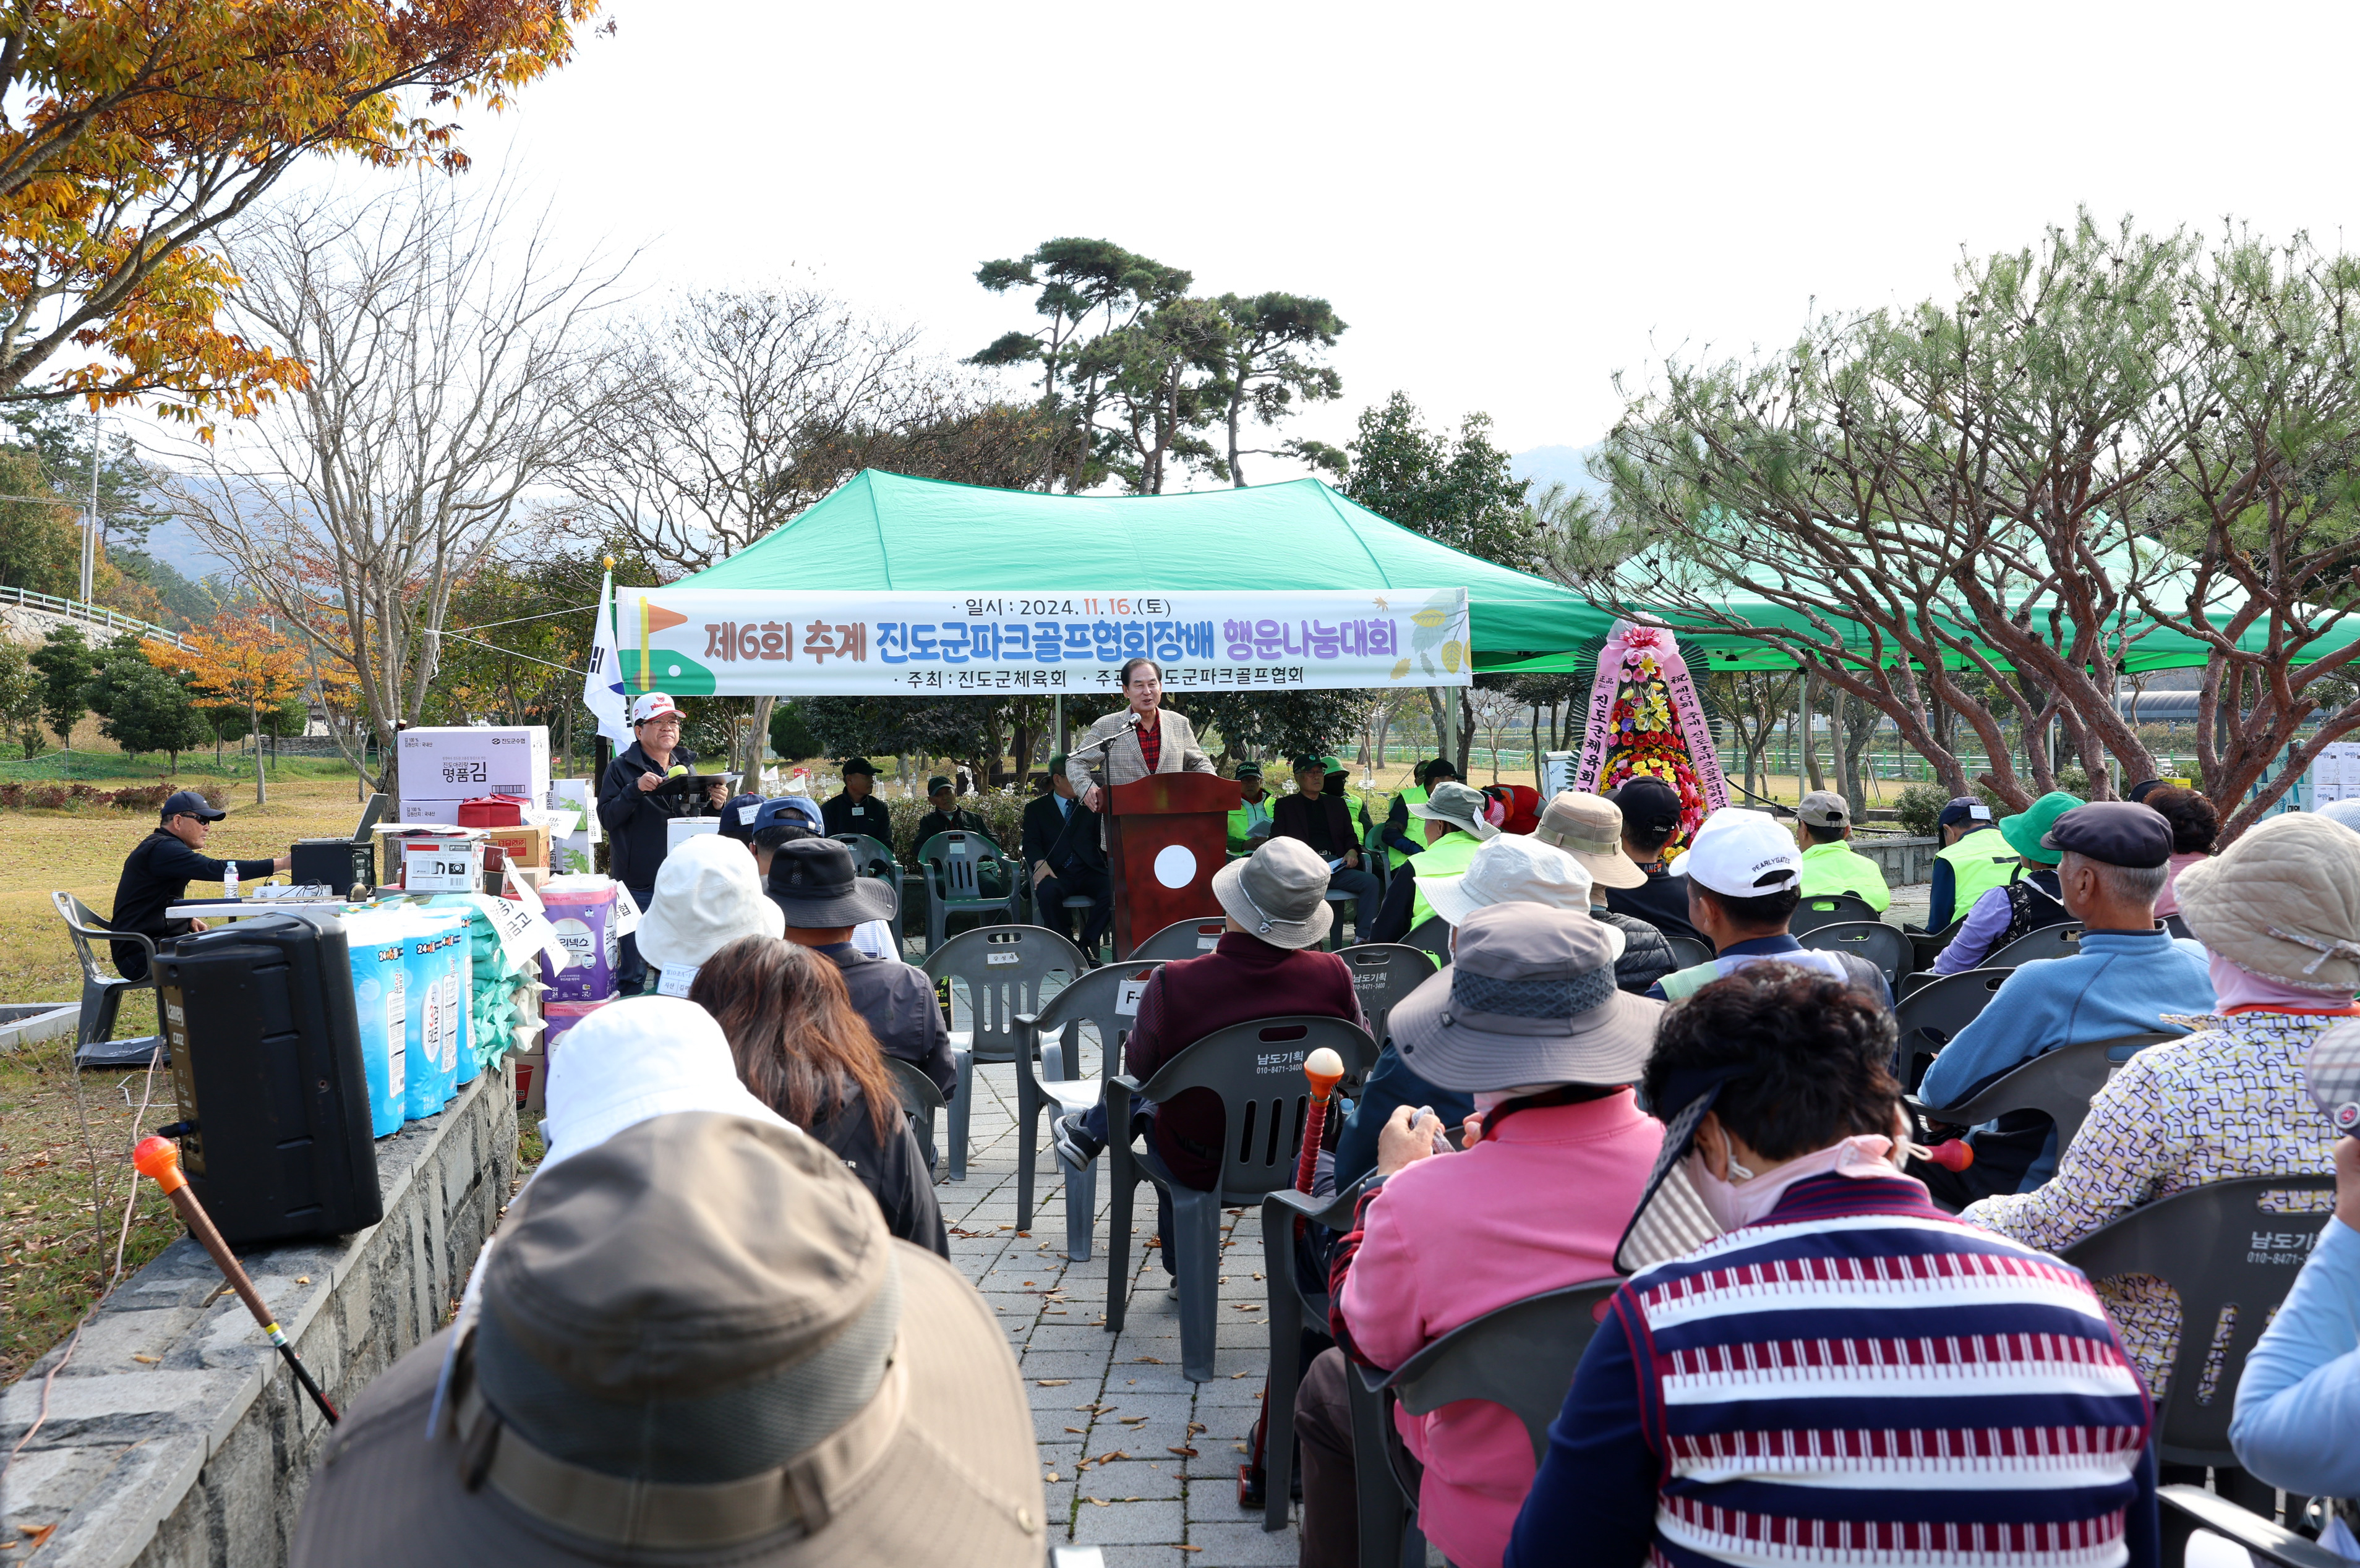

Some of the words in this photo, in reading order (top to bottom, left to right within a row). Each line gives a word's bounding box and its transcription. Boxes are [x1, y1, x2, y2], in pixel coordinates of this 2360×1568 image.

[965, 598, 1003, 616] 일시
[704, 620, 794, 663] 제6회
[803, 619, 867, 664] 추계
[876, 619, 1215, 664] 진도군파크골프협회장배
[1223, 618, 1398, 660] 행운나눔대회
[907, 670, 943, 689] 주최
[957, 669, 1067, 689] 진도군체육회
[1160, 666, 1304, 686] 도군파크골프협회
[1670, 673, 1689, 685] 祝
[1644, 863, 1662, 873] ANEW
[1751, 856, 1791, 872] PEARLYGATES
[1353, 972, 1387, 983] 남도기획
[1257, 1050, 1304, 1065] 남도기획
[1256, 1063, 1302, 1075] 010-8471-3400
